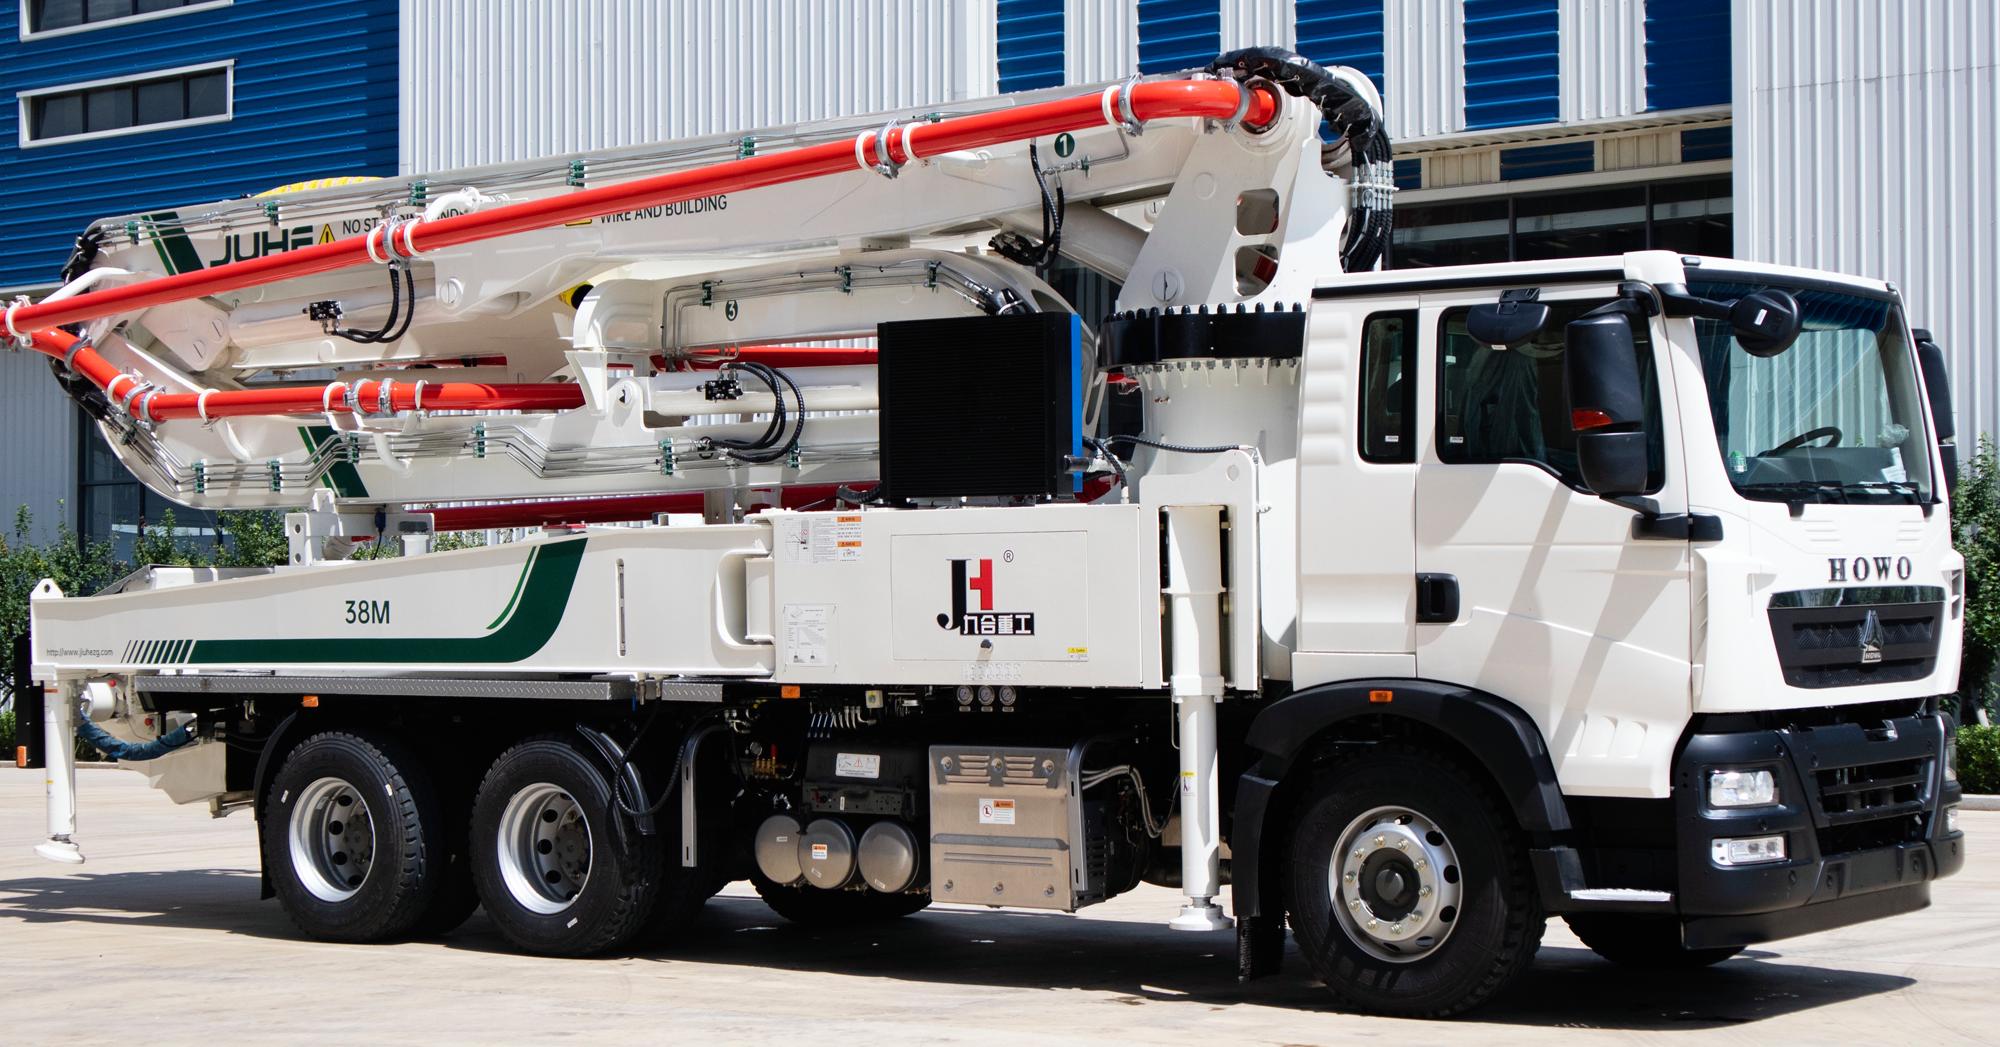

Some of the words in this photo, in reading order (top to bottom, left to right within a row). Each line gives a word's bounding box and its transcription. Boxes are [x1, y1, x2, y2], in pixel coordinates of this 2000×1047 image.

[665, 194, 728, 217] BUILDING
[342, 219, 361, 235] NO
[1828, 556, 1913, 582] HOWO
[344, 600, 391, 624] 38M
